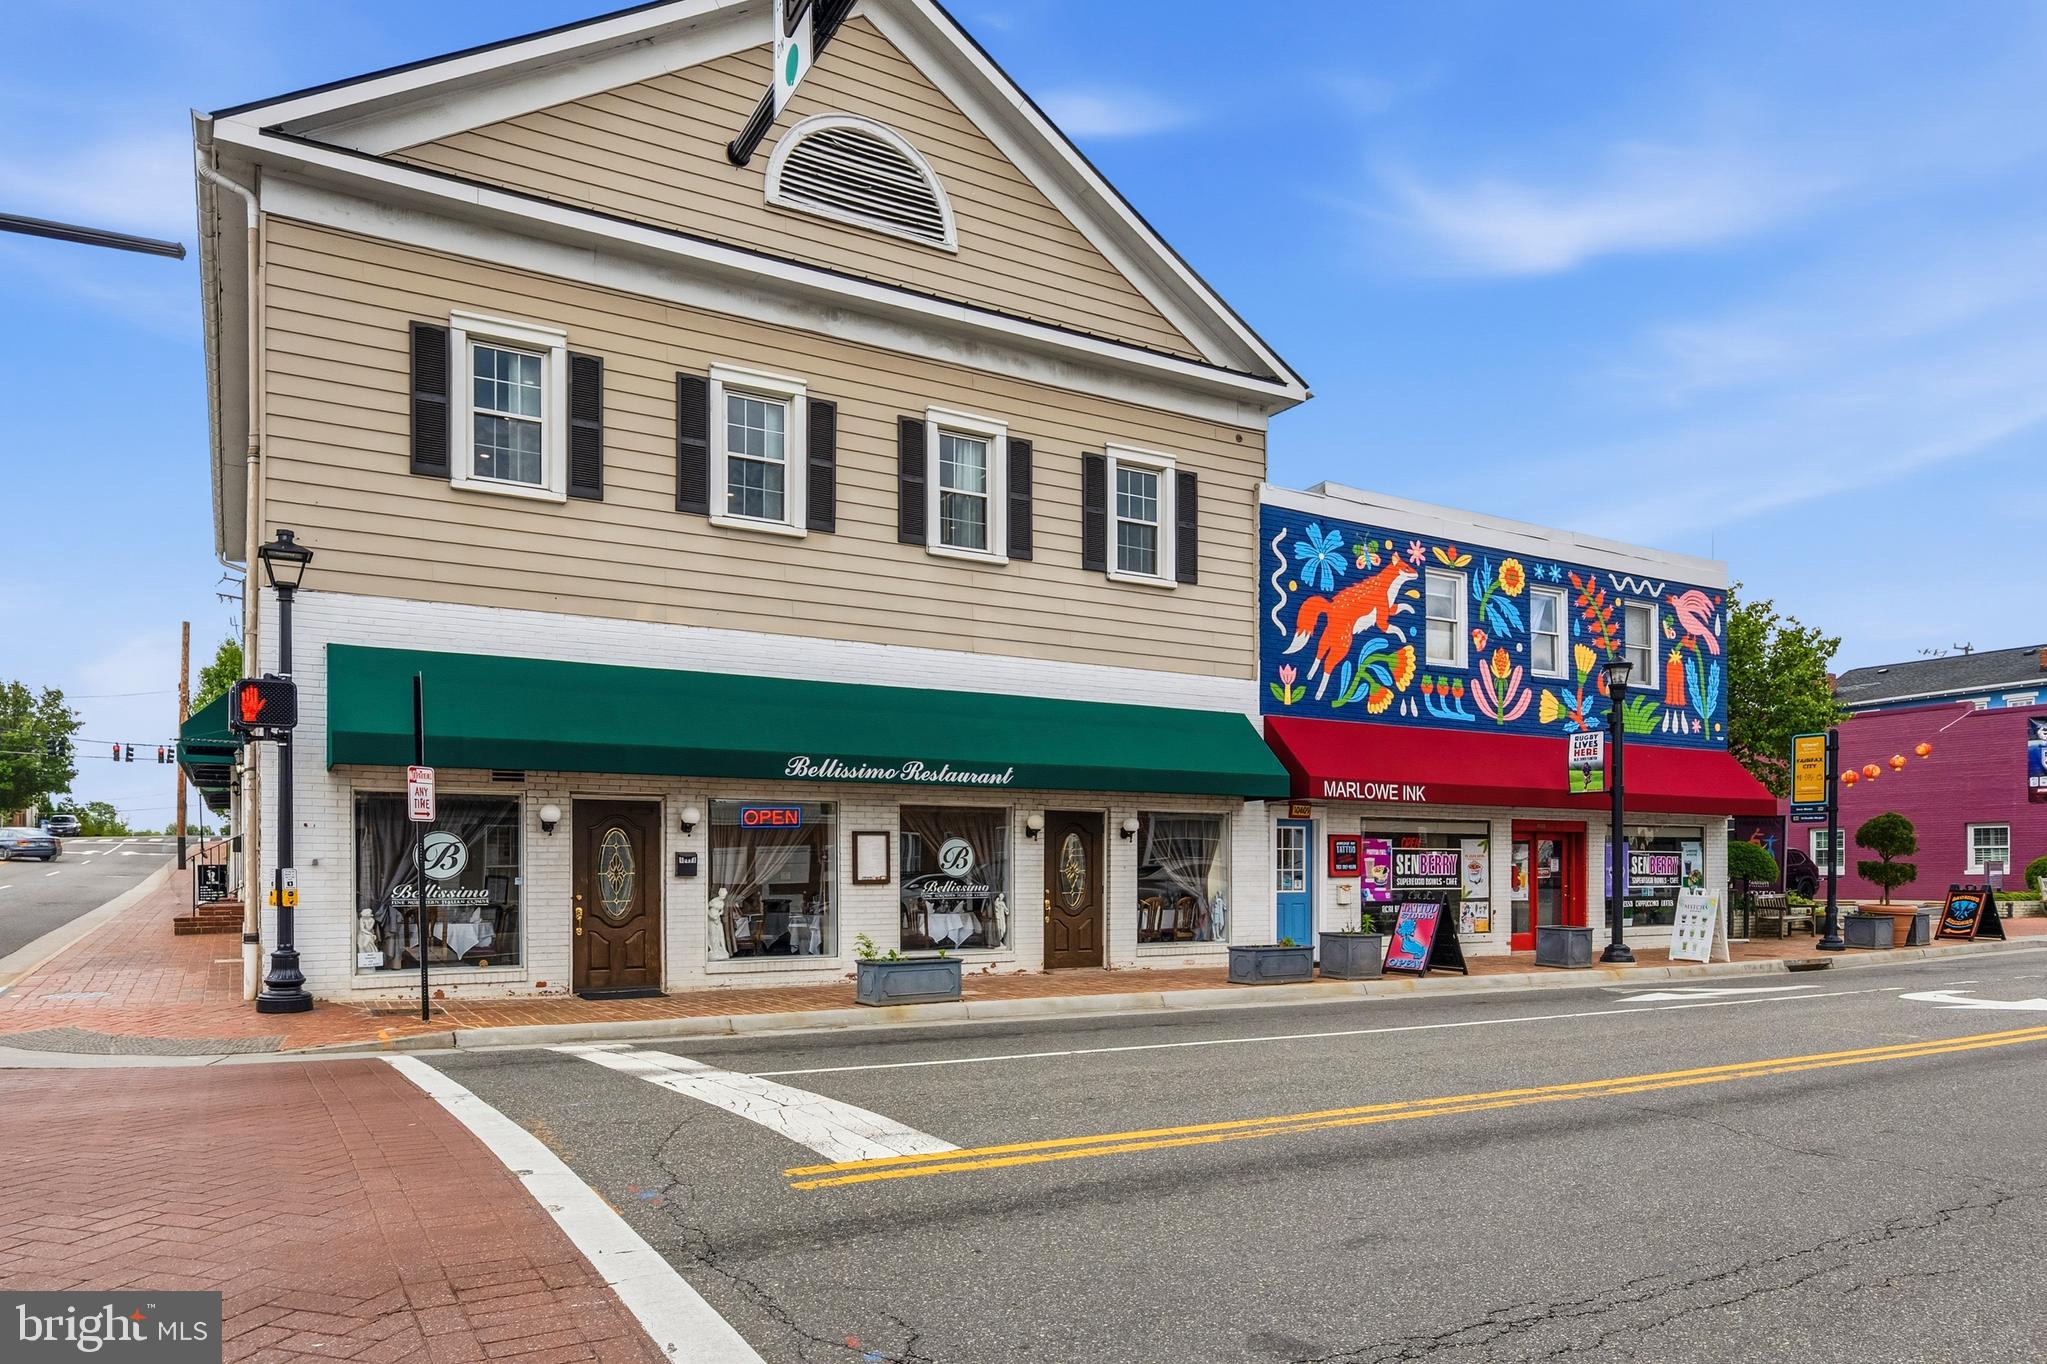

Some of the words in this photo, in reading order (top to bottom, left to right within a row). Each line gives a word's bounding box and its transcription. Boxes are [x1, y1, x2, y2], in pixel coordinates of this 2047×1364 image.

[1574, 740, 1598, 749] LIVES
[1574, 748, 1598, 757] HERE
[785, 755, 899, 779] Bellissimo
[900, 760, 1014, 785] Restaurant
[415, 787, 428, 797] ANY
[1324, 780, 1399, 800] MARLOWE
[1403, 785, 1426, 801] INK
[414, 798, 430, 809] TIME
[744, 810, 798, 825] OPEN
[423, 841, 462, 871] B
[941, 845, 970, 870] B
[923, 880, 989, 893] Bellissimo
